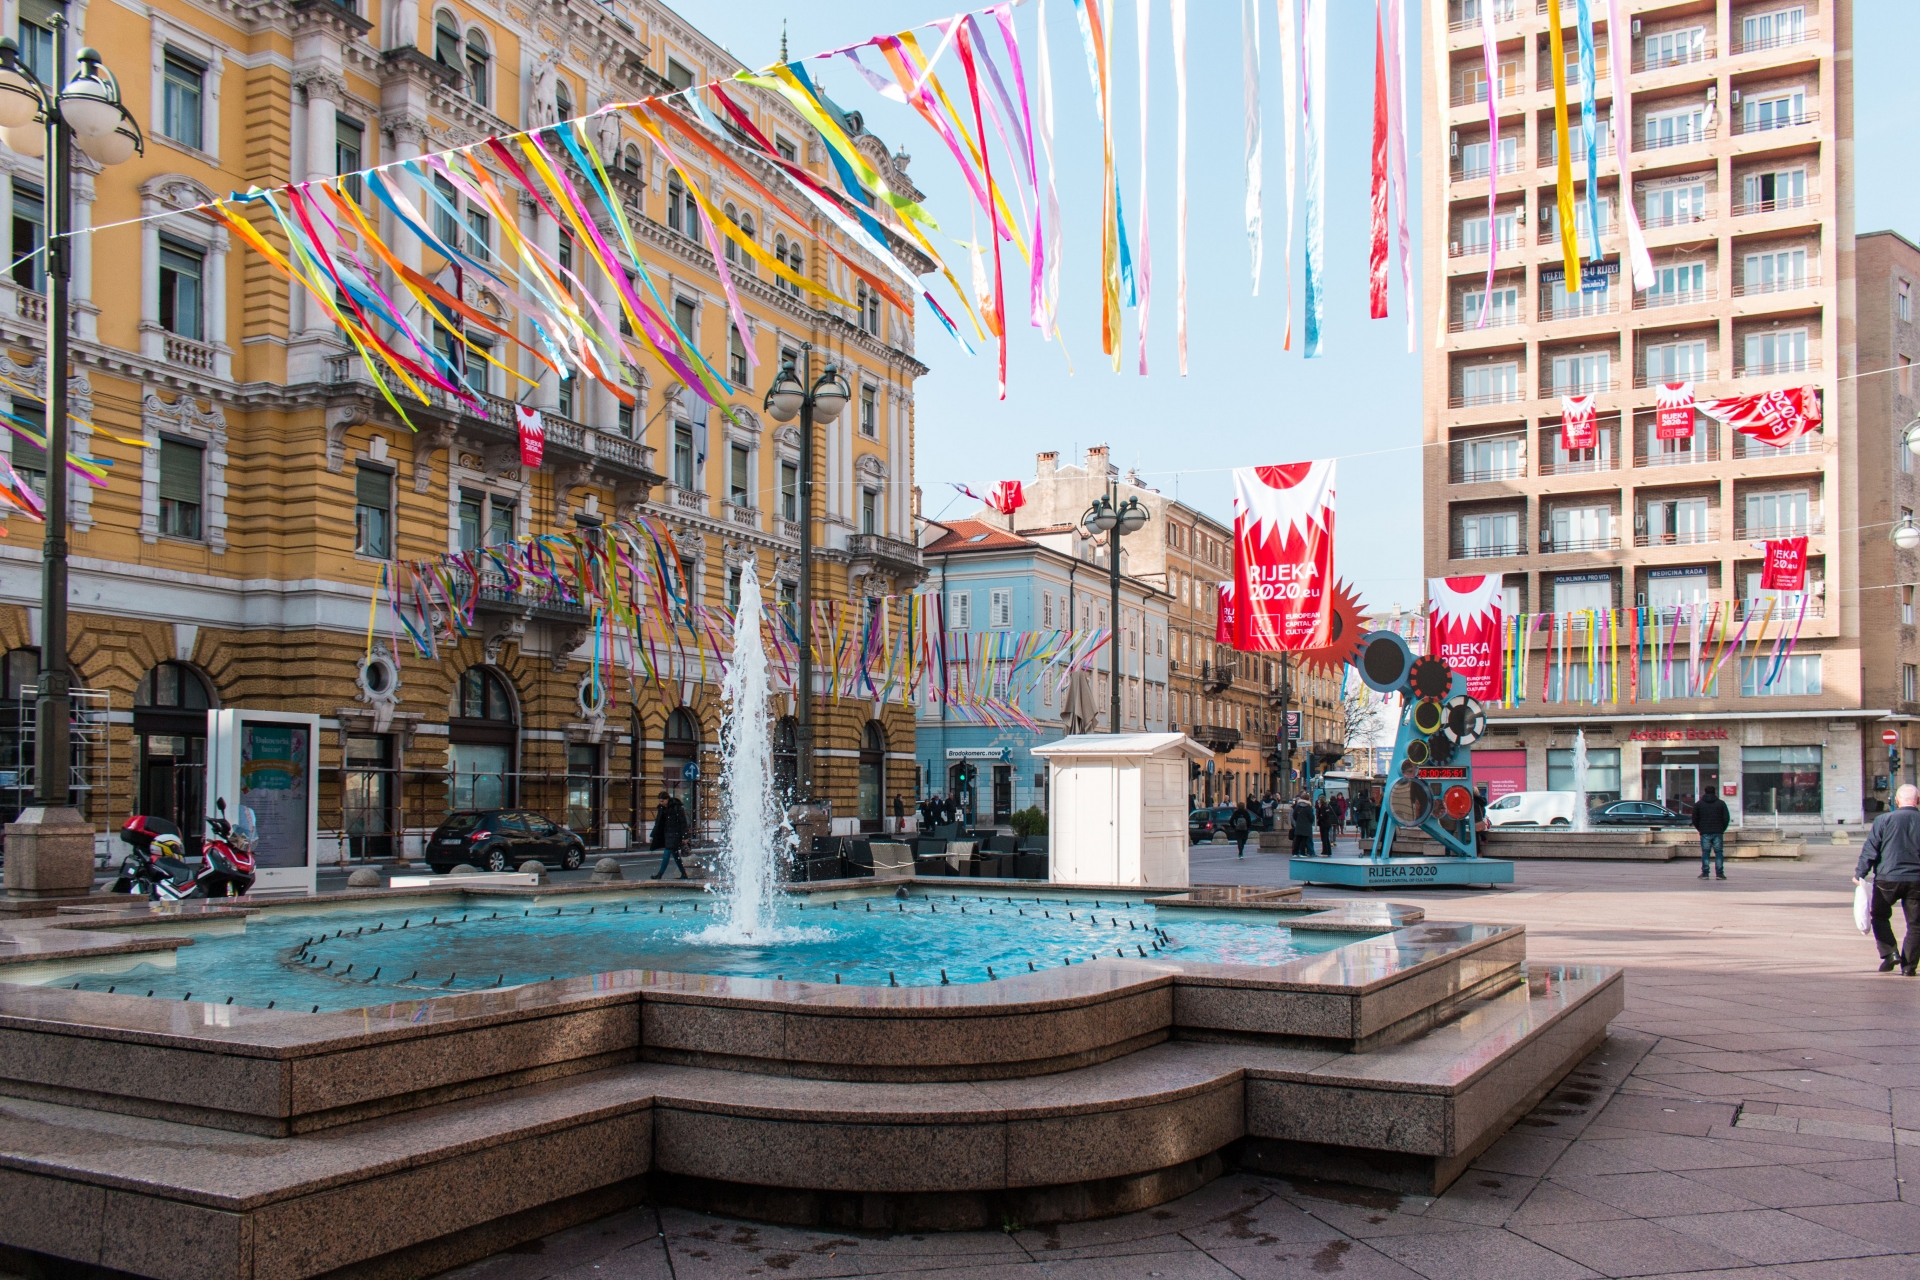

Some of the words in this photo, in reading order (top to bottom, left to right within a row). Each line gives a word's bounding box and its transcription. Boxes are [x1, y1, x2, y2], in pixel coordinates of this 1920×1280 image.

[1597, 264, 1618, 275] RIJECI
[1249, 561, 1320, 581] RIJEKA
[1555, 574, 1587, 583] POLIKLINIKA
[1249, 582, 1320, 601] 2020.eu
[1285, 612, 1321, 620] EUROPEAN
[1285, 620, 1311, 628] CAPITAL
[1285, 628, 1315, 636] CULTURE
[1441, 642, 1490, 656] RIJEKA
[1628, 727, 1685, 740] Addiko
[1686, 726, 1728, 740] Bank
[1369, 866, 1407, 877] RIJEKA
[1409, 865, 1438, 876] 2020
